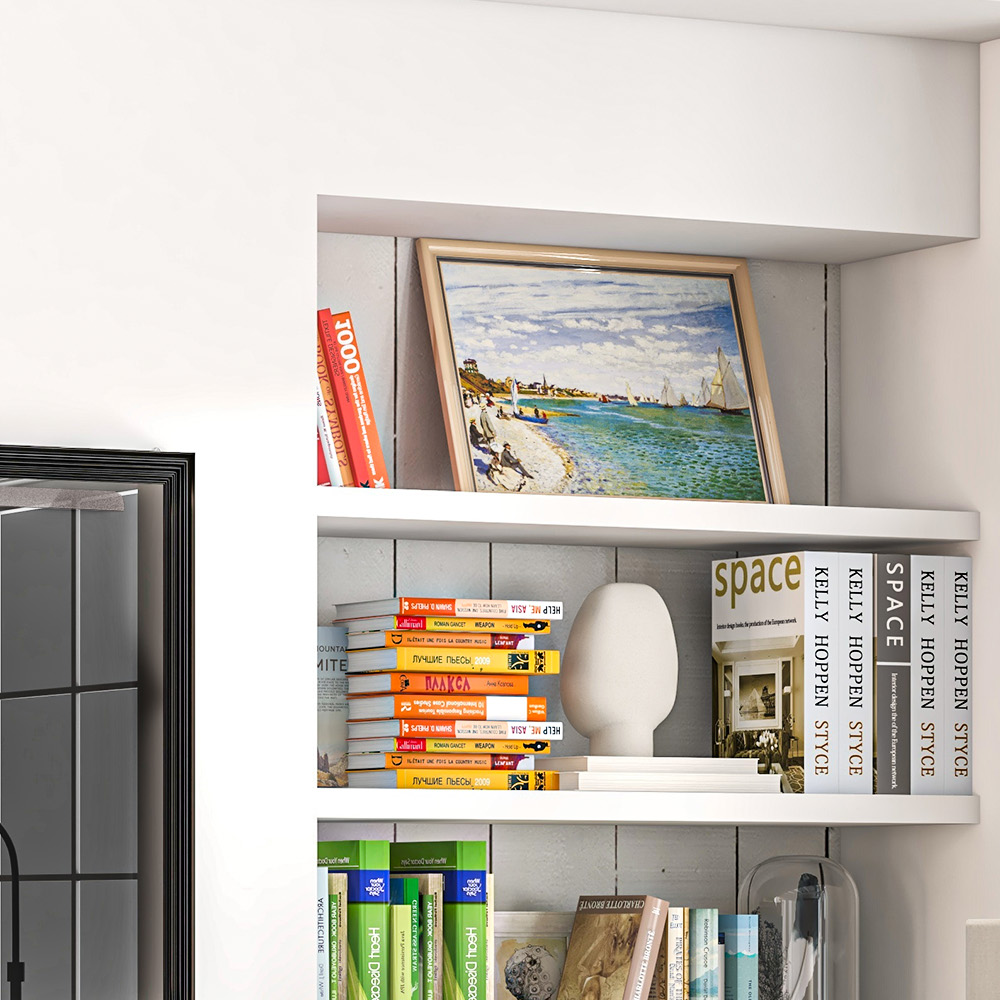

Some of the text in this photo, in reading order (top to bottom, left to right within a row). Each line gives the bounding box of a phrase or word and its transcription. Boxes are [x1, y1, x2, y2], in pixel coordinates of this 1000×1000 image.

[714, 554, 802, 609] space
[411, 602, 429, 610] PHELPS
[511, 605, 526, 613] ASIA
[543, 606, 560, 614] HELP
[885, 562, 904, 647] SPACE
[412, 655, 443, 664] ЛУЧШИЕ
[815, 567, 829, 775] KELLY HOPPEN STYCE
[849, 568, 863, 776] KELLY HOPPEN STYCE
[921, 570, 935, 777] KELLY HOPPEN STYCE
[954, 571, 968, 777] KELLY HOPPEN STYCE
[425, 676, 471, 692] ПЛАКСА
[890, 672, 898, 692] Interior
[890, 693, 898, 712] design
[511, 726, 526, 734] ASIA
[543, 726, 560, 735] HELP
[890, 738, 898, 764] European
[412, 776, 443, 785] ЛУЧШИЕ
[606, 900, 645, 910] CHARLOTTE
[675, 974, 682, 983] OF
